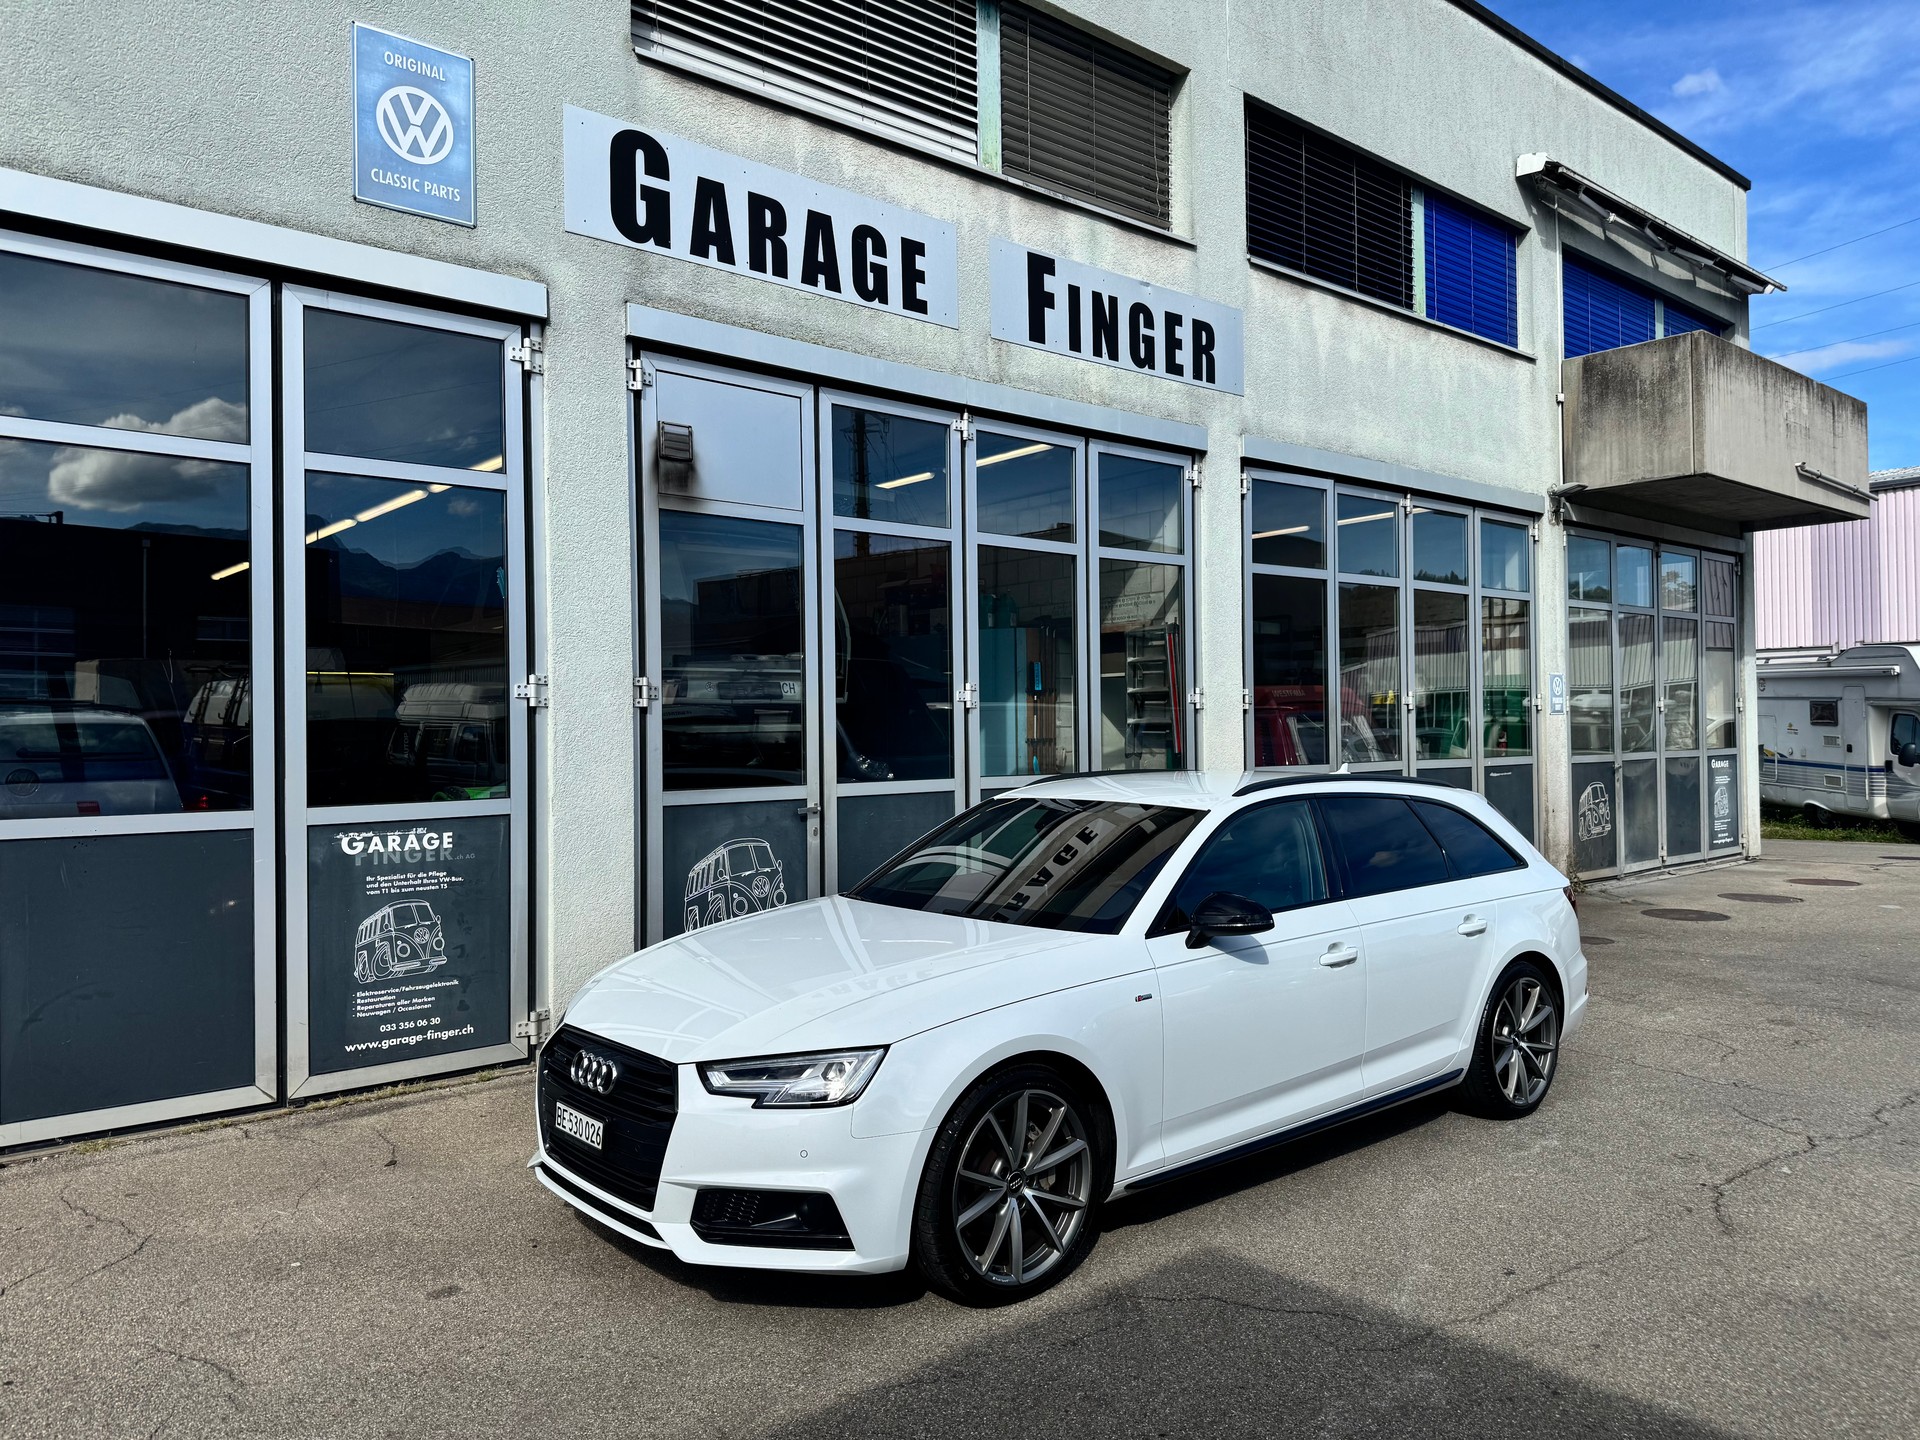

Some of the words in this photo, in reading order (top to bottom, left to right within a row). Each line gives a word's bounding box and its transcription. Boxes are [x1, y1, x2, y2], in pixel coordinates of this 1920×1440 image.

[383, 50, 447, 82] ORIGINAL
[370, 167, 421, 194] CLASSIC
[423, 177, 462, 203] PARTS
[609, 128, 929, 315] GARAGE
[1026, 251, 1217, 384] FINGER
[781, 682, 796, 694] CH
[341, 831, 453, 855] GARAGE
[377, 873, 405, 882] Spezialist
[428, 870, 448, 878] Pflege
[393, 879, 422, 887] Unterhalt
[356, 994, 397, 1005] Restauration
[356, 1001, 396, 1012] Reparaturen
[396, 998, 411, 1006] aller
[411, 995, 436, 1004] Marken
[356, 1008, 391, 1018] Neuwagen
[397, 1003, 432, 1013] Occasionen
[379, 1023, 397, 1032] 033
[398, 1021, 415, 1030] 356
[416, 1018, 428, 1027] 06
[429, 1016, 441, 1025] 30
[344, 1024, 474, 1052] www.garage-finger.ch
